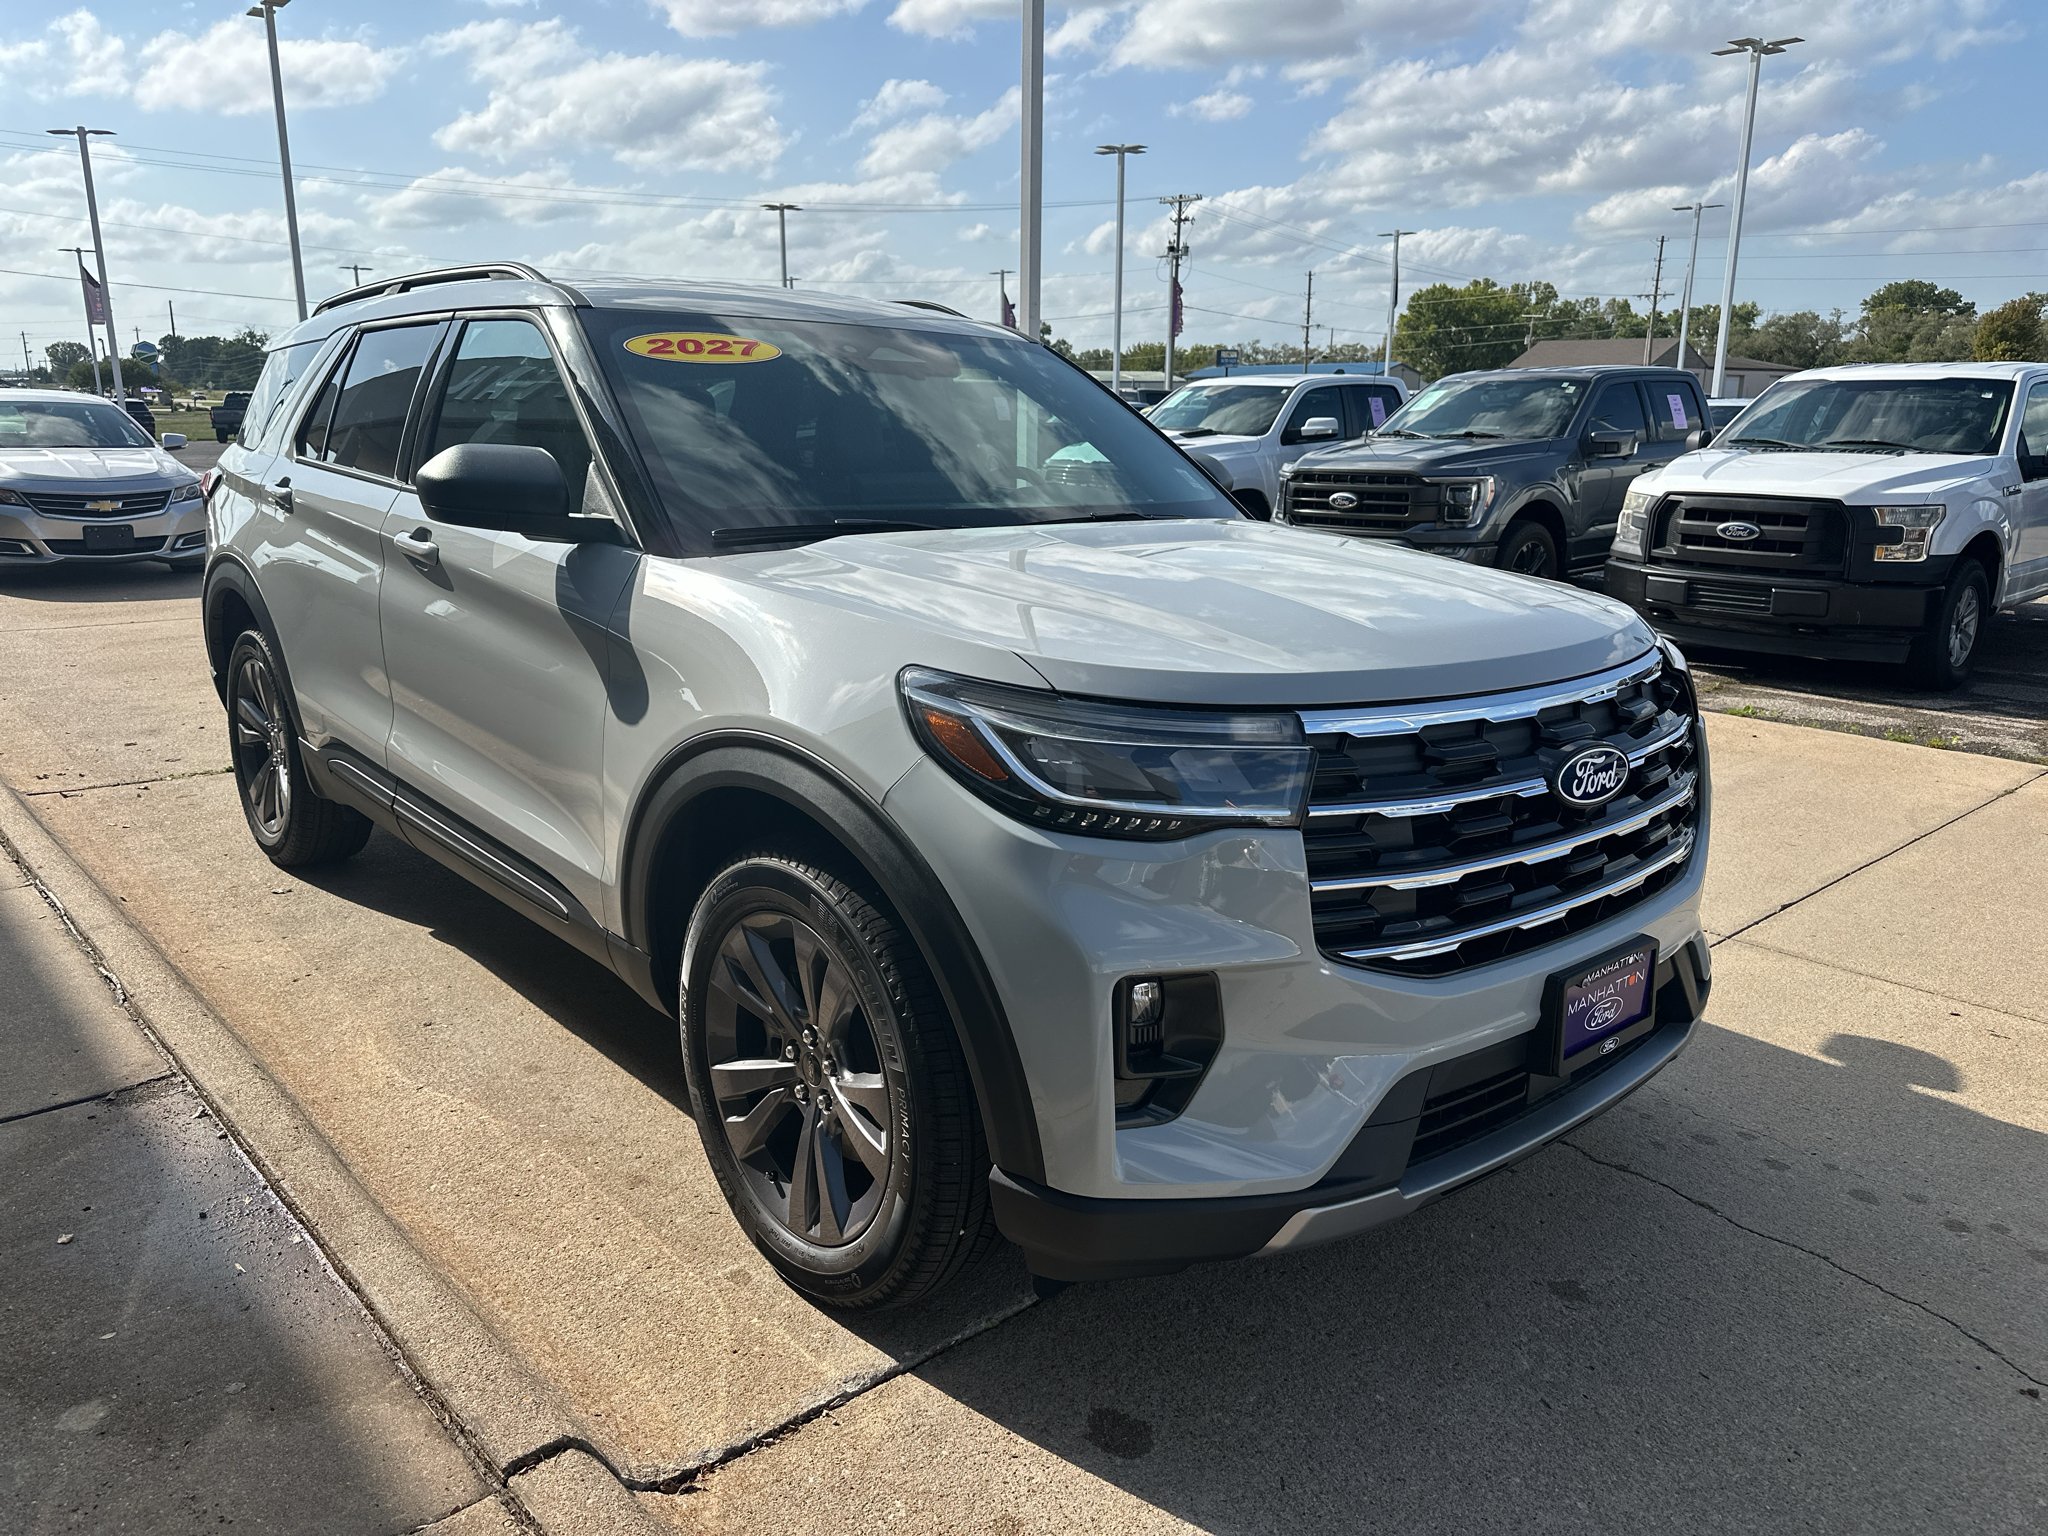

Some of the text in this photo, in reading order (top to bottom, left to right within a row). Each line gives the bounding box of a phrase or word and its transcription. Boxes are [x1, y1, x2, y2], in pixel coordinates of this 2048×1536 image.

[646, 338, 760, 357] 2027
[1726, 525, 1750, 537] Ford
[1572, 755, 1618, 797] Ford
[1591, 1001, 1617, 1027] Ford
[1602, 1039, 1616, 1052] Ford
[897, 1087, 910, 1163] PRIMACY
